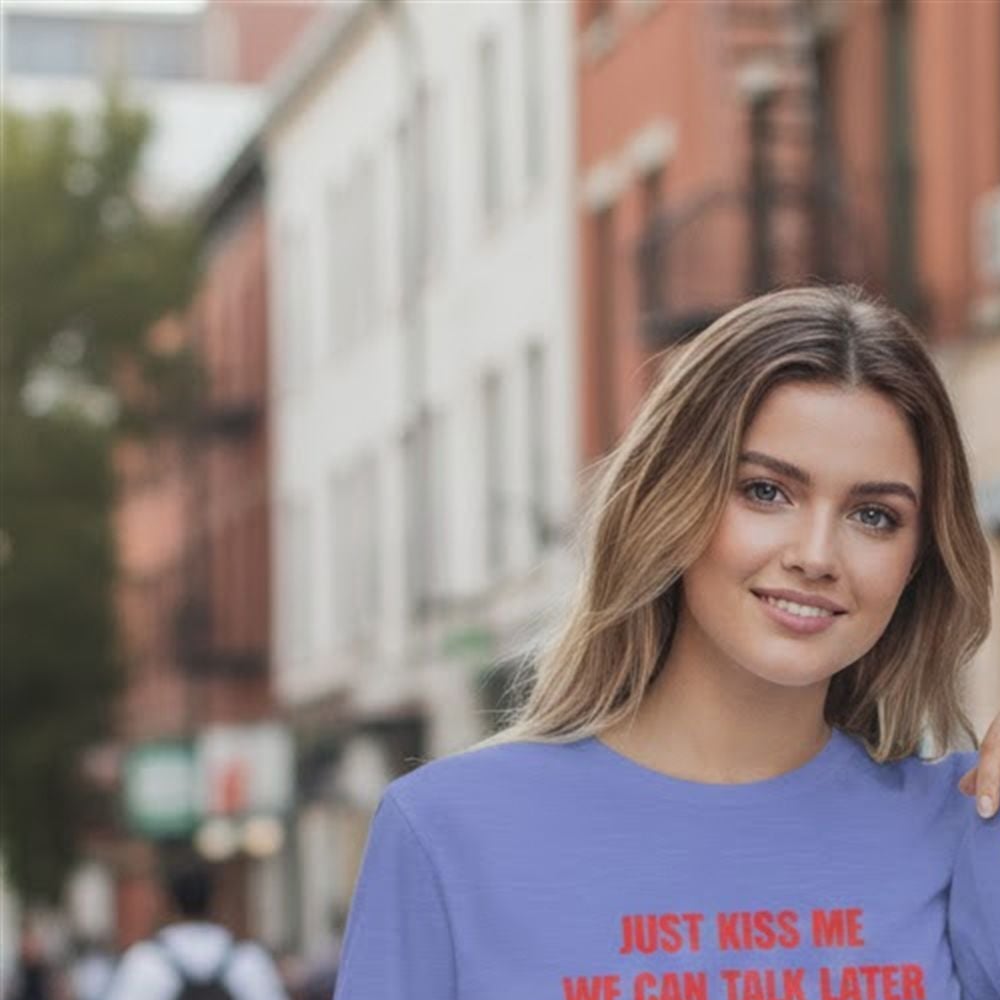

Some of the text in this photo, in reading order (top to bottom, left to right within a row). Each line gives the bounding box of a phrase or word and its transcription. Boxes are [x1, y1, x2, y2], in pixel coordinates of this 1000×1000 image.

[619, 908, 865, 955] JUST KISS ME
